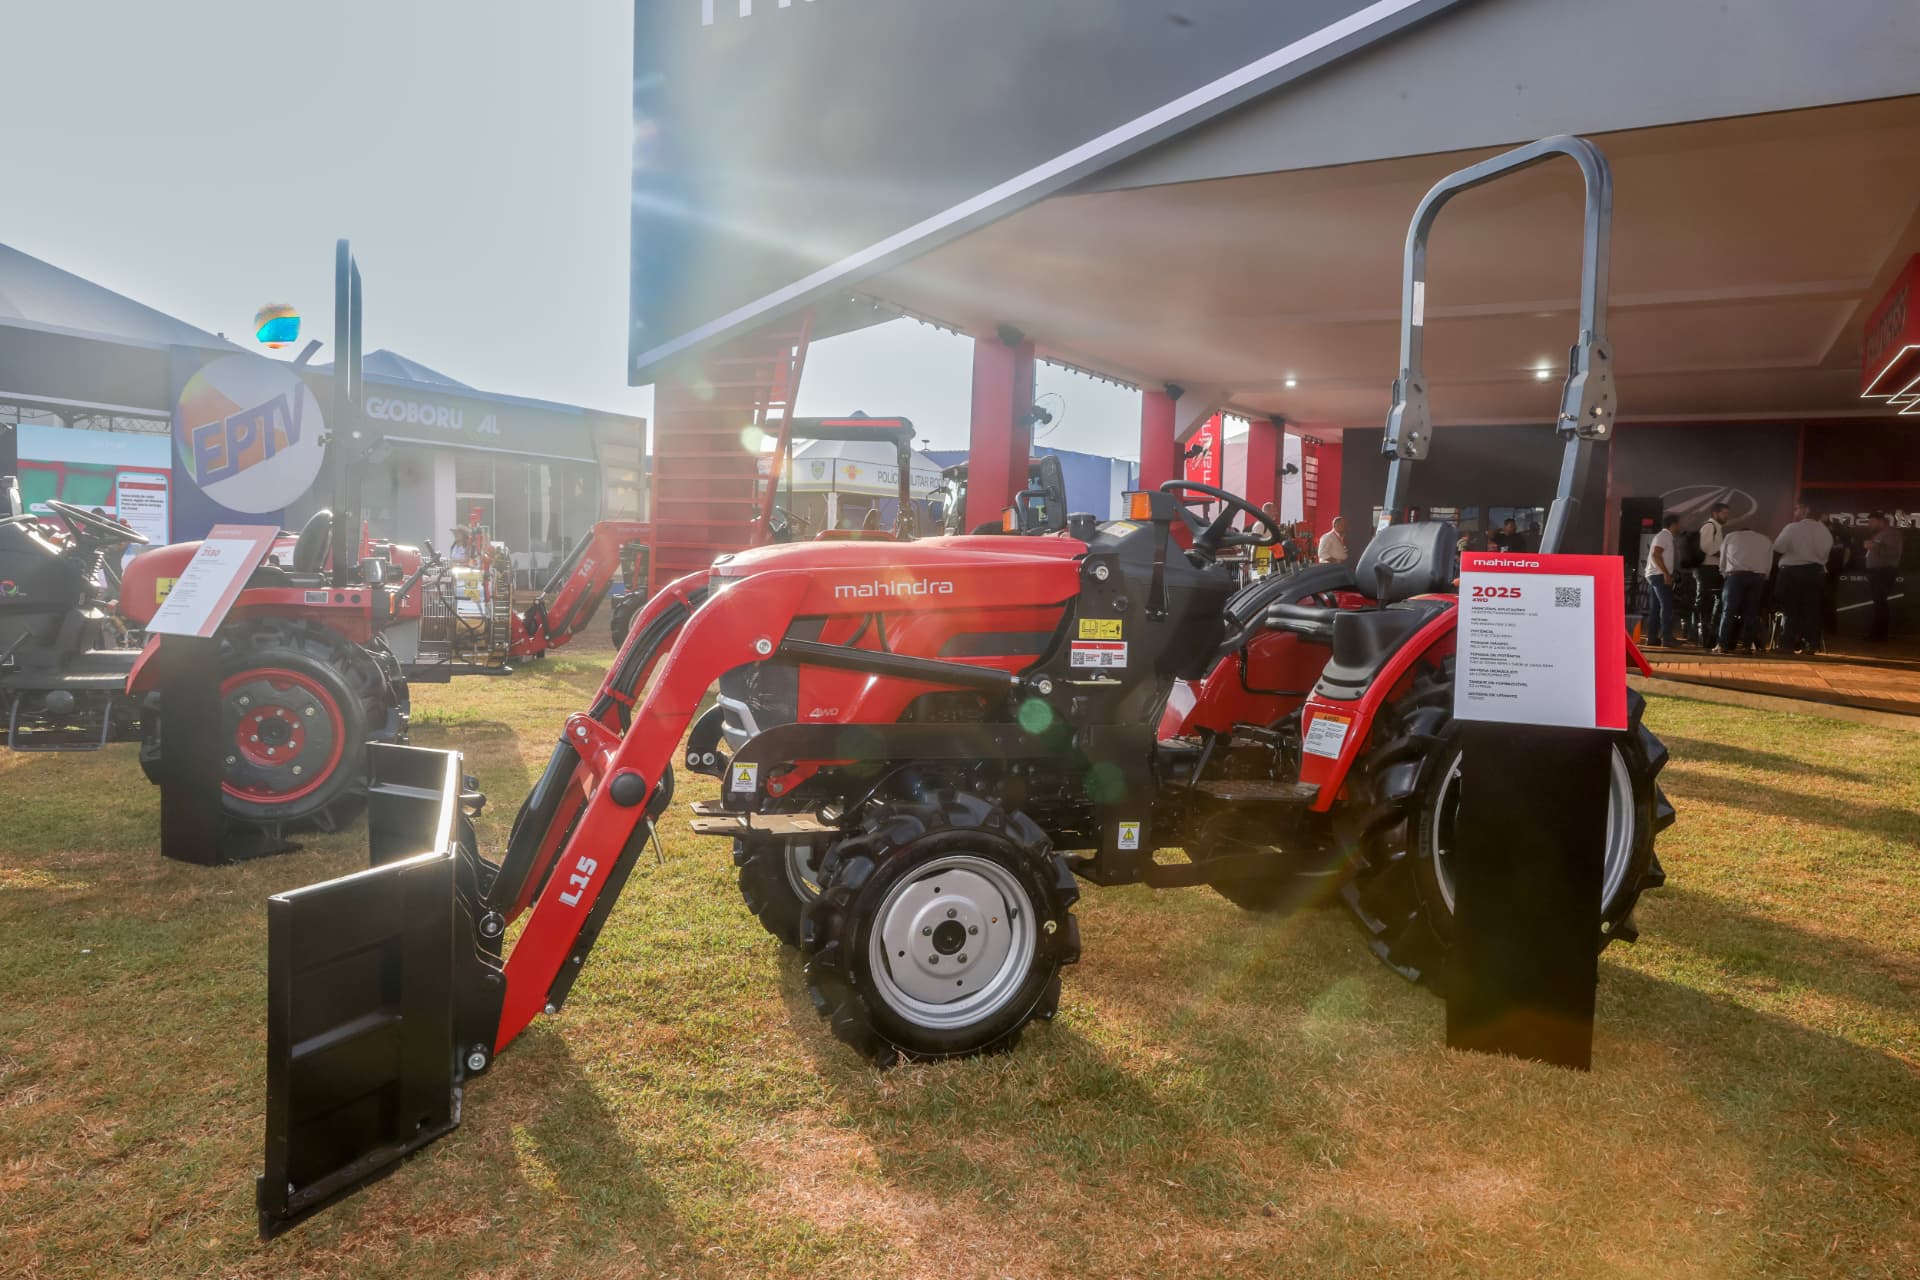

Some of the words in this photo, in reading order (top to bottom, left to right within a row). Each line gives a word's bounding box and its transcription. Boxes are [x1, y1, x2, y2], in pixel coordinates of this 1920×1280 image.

[193, 382, 304, 487] EPTV
[1473, 559, 1540, 568] mahindra
[835, 578, 953, 598] mahindra
[1472, 586, 1521, 598] 2025
[809, 707, 839, 718] 4WD
[558, 855, 598, 908] L15
